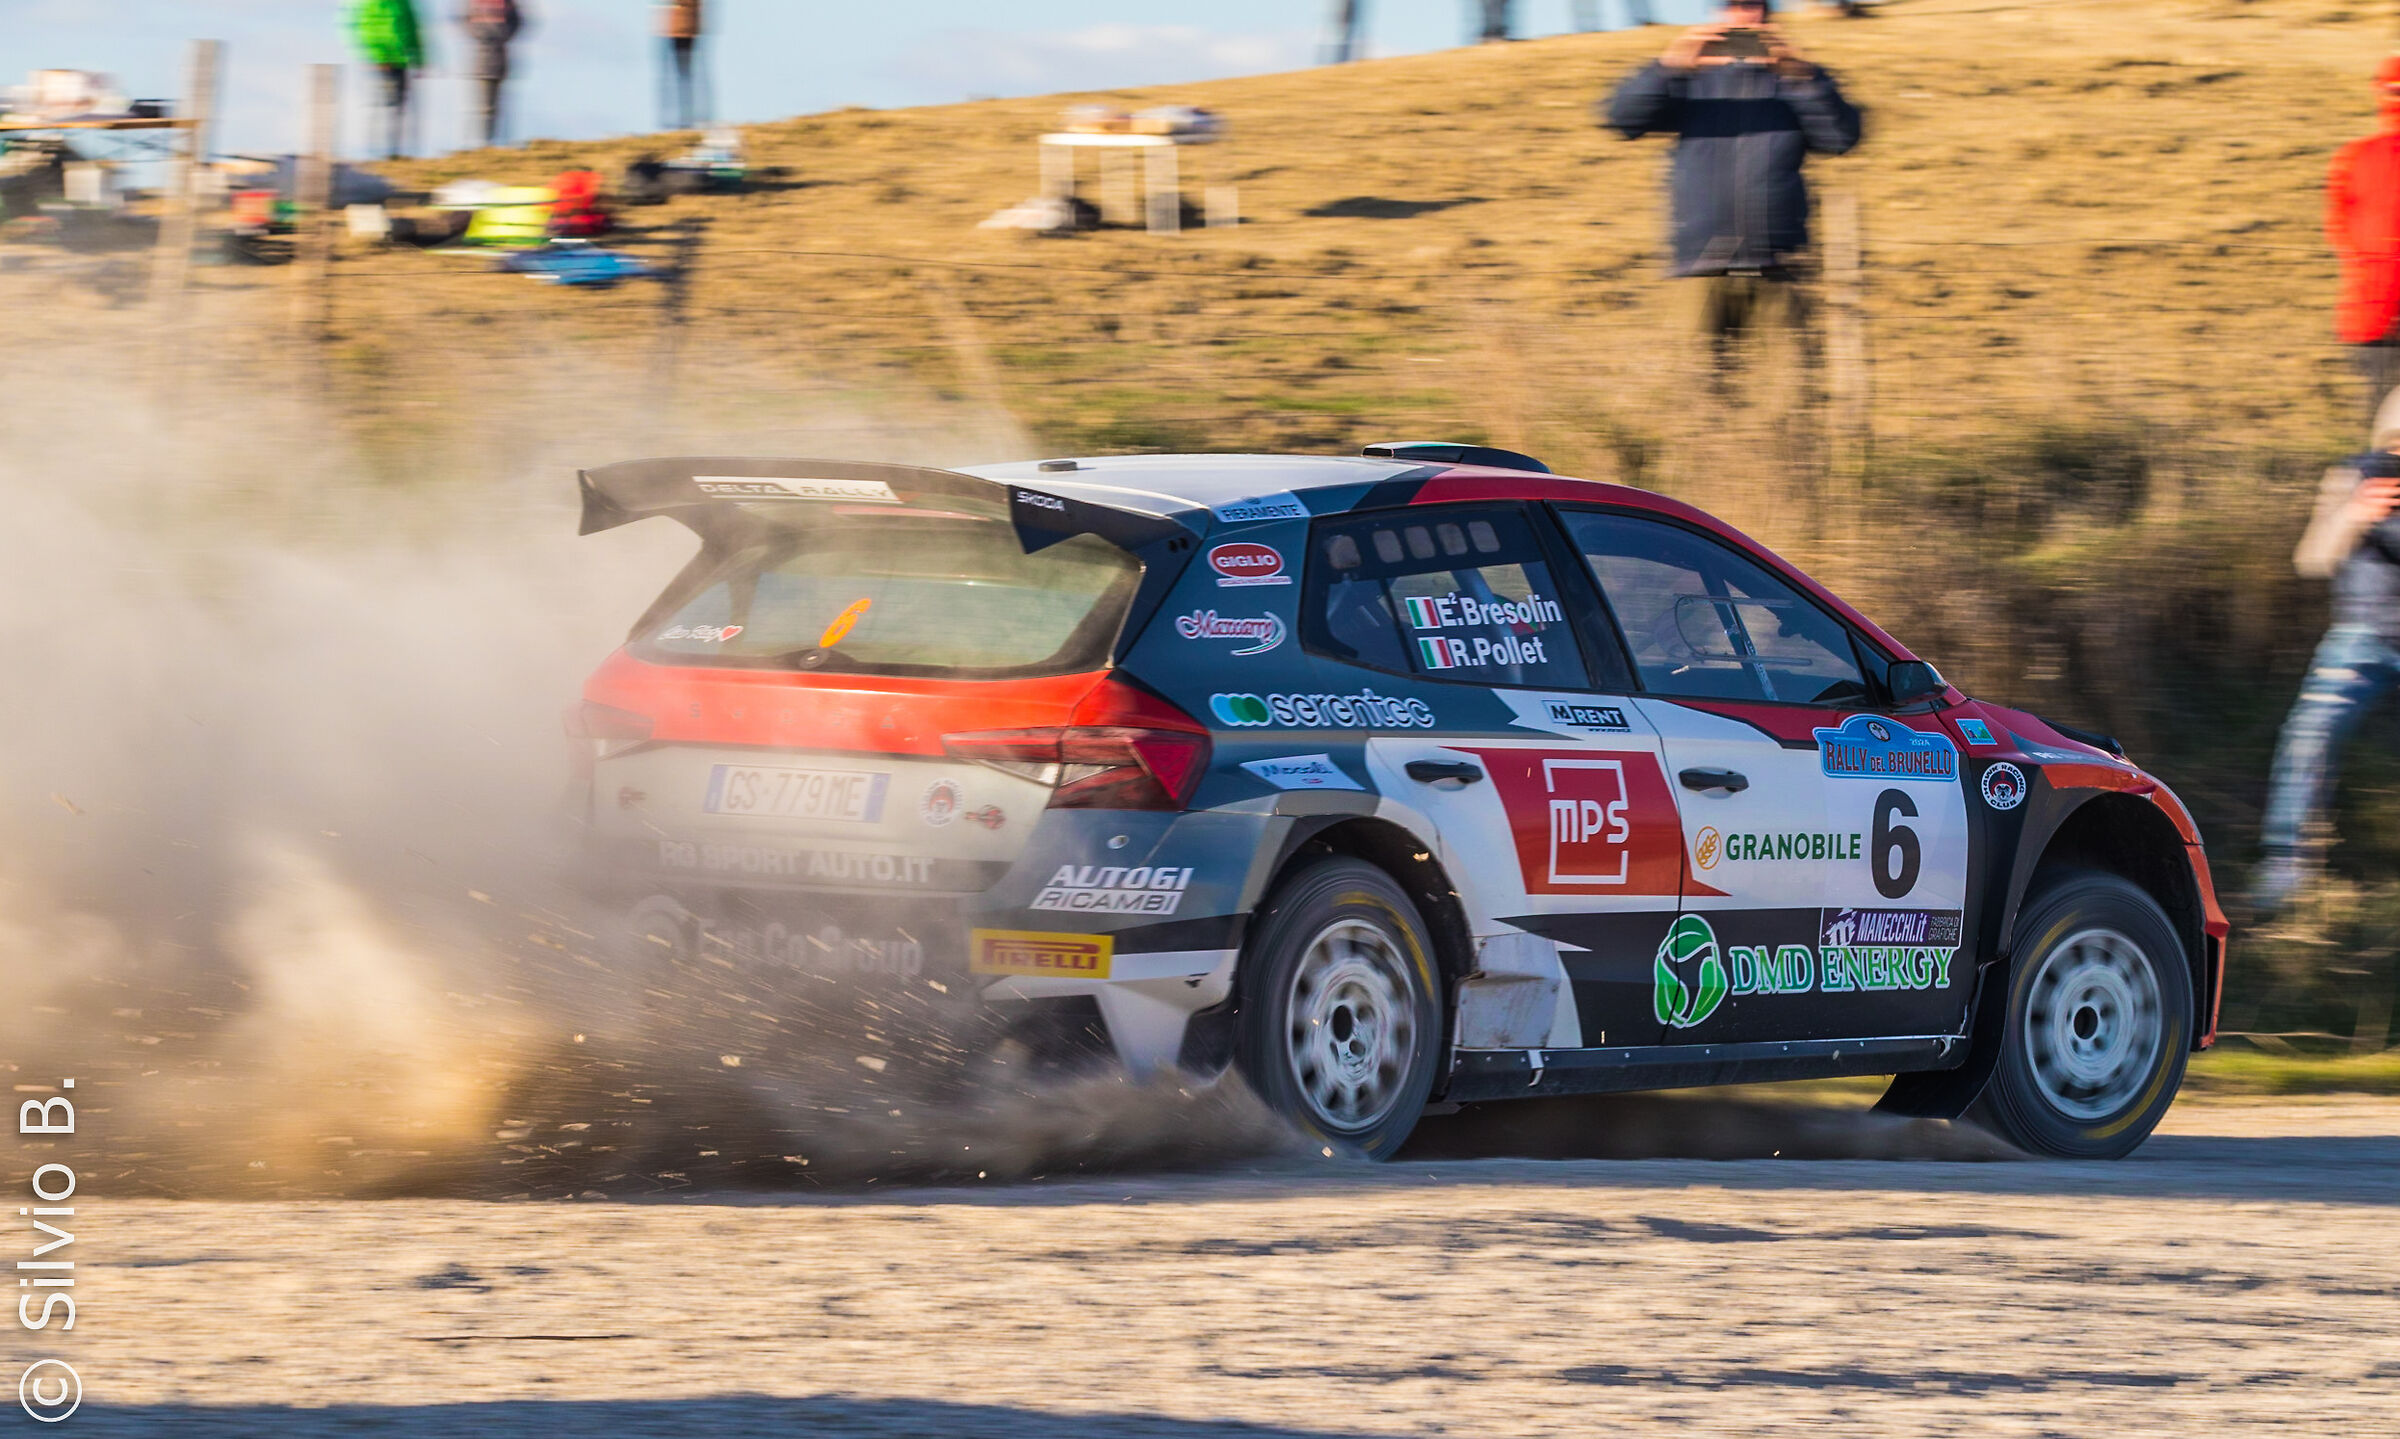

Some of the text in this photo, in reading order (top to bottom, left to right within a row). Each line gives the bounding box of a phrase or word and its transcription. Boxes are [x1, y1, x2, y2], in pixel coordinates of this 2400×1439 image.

[699, 483, 888, 498] DELTA RALLY
[1220, 503, 1301, 519] FIERAMENTE
[1216, 555, 1277, 567] GIGLIO
[819, 598, 872, 648] 6
[1448, 636, 1548, 666] R.Pollet
[1267, 688, 1436, 728] serentec
[1573, 708, 1622, 725] RENT
[1825, 741, 1951, 775] RALLY DEL BRUNELLO
[727, 770, 761, 811] GS
[1982, 765, 2025, 794] HAWK RACING
[1990, 799, 2018, 809] CLUB
[1726, 833, 1861, 860] GRANOBILE
[1870, 788, 1921, 899] 6
[702, 843, 800, 875] SPORT
[806, 851, 935, 884] AUTO.IT
[1047, 864, 1195, 890] AUTOGI
[1038, 890, 1178, 912] RICAMBI
[1857, 912, 1928, 942] MANECCHI.it
[982, 938, 1101, 970] PIRELLI
[1730, 945, 1955, 995] DMD ENERGY
